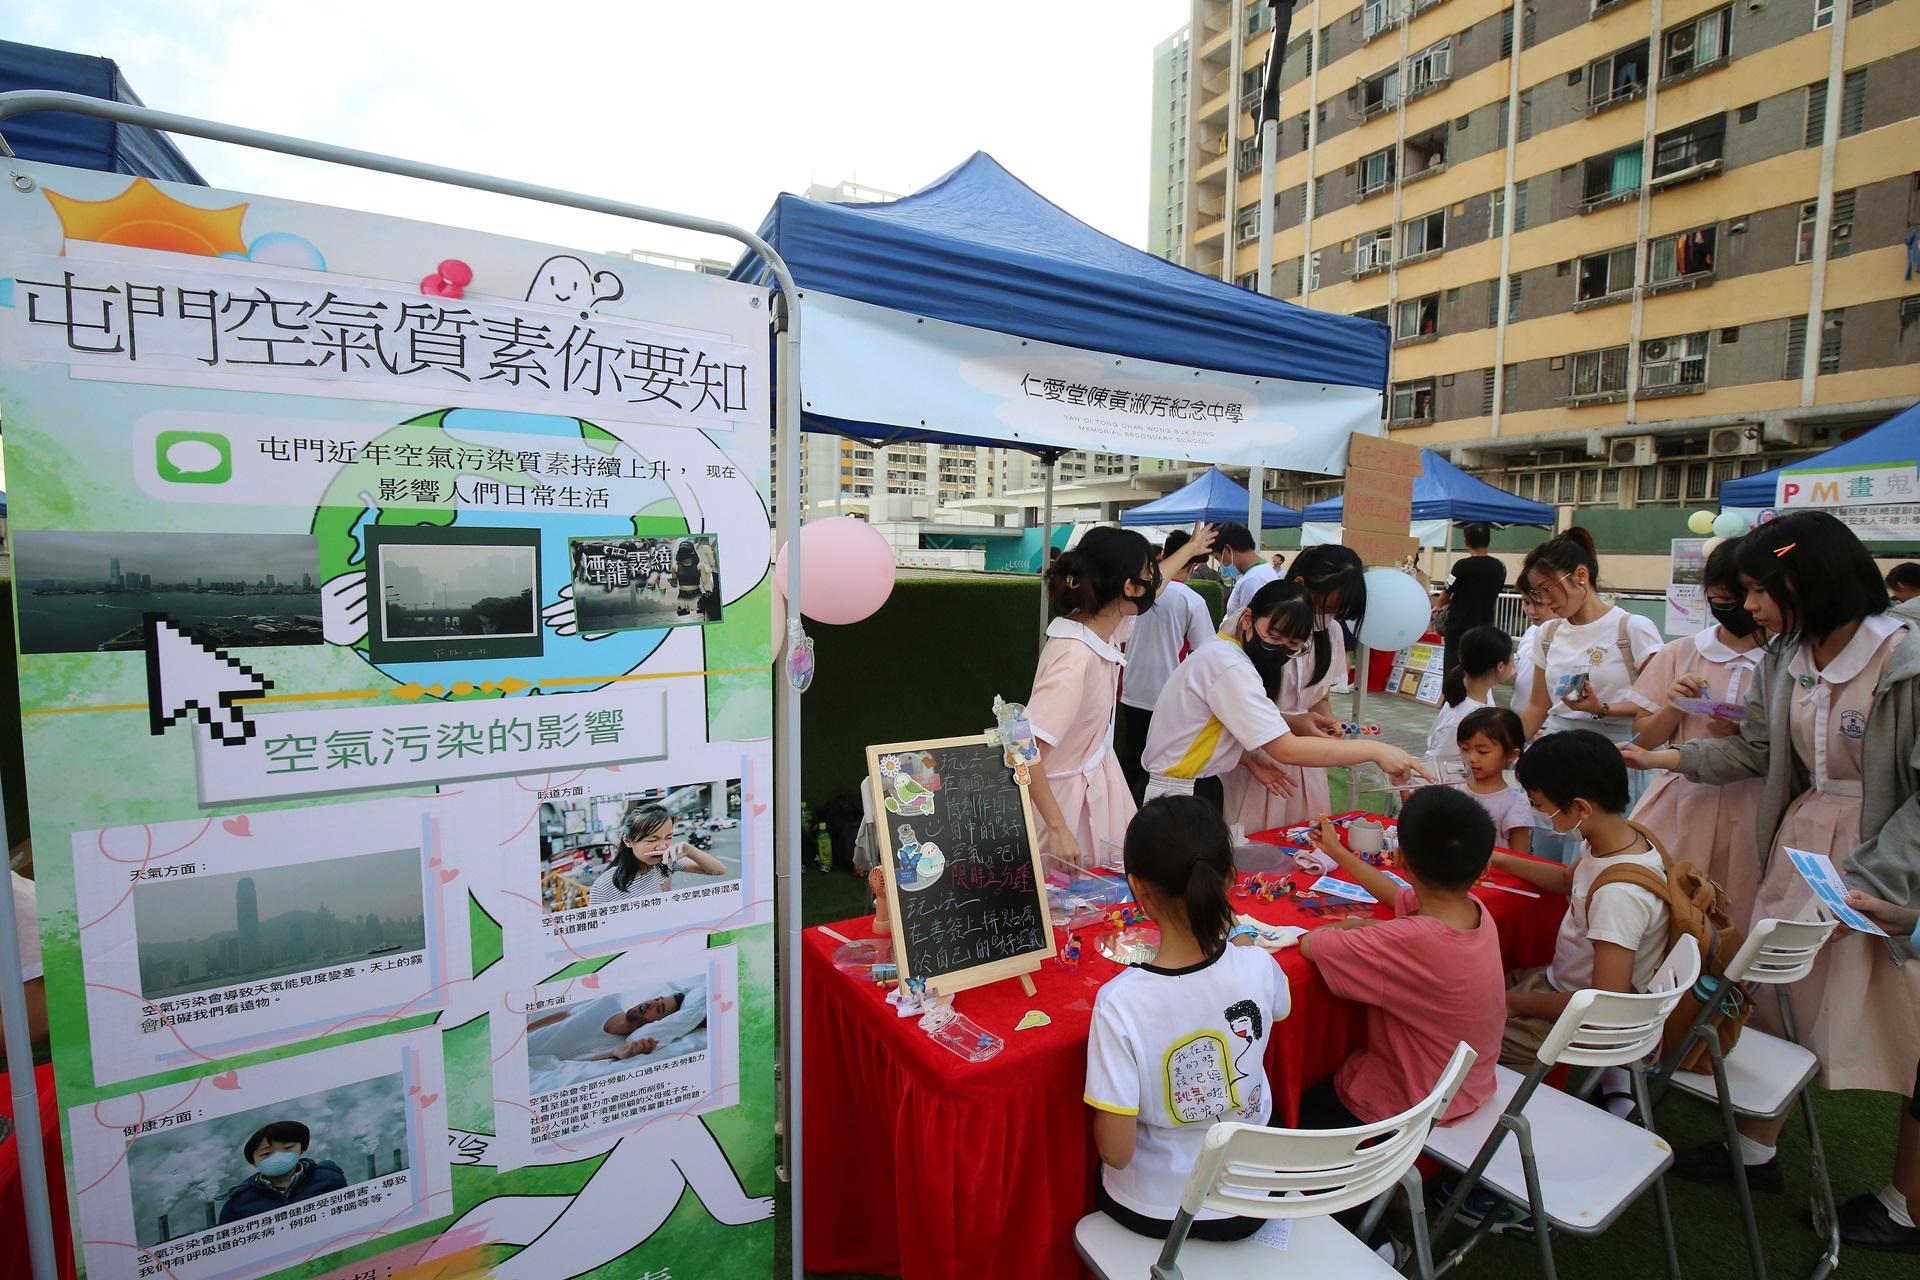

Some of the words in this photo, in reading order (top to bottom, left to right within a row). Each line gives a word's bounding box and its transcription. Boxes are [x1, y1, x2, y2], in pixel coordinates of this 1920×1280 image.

[15, 270, 748, 413] 屯門空氣質素你要知
[1020, 372, 1245, 424] 仁愛堂陳黃淑芳紀念中學
[1078, 425, 1121, 436] MEMORIAL
[1124, 431, 1173, 442] SECONDARY
[1176, 437, 1209, 445] SCHOOL
[1096, 419, 1119, 428] TONG
[1121, 423, 1144, 431] CHAN
[1146, 425, 1171, 434] WONG
[257, 436, 686, 481] 屯門近年空氣污染質素持續上升，
[378, 477, 610, 509] 影響人們日常生活
[264, 709, 625, 775] 空氣污染的影響
[537, 785, 591, 800] 味道方面：
[130, 862, 207, 881] 天氣方面：
[122, 1108, 204, 1138] 健康方面：
